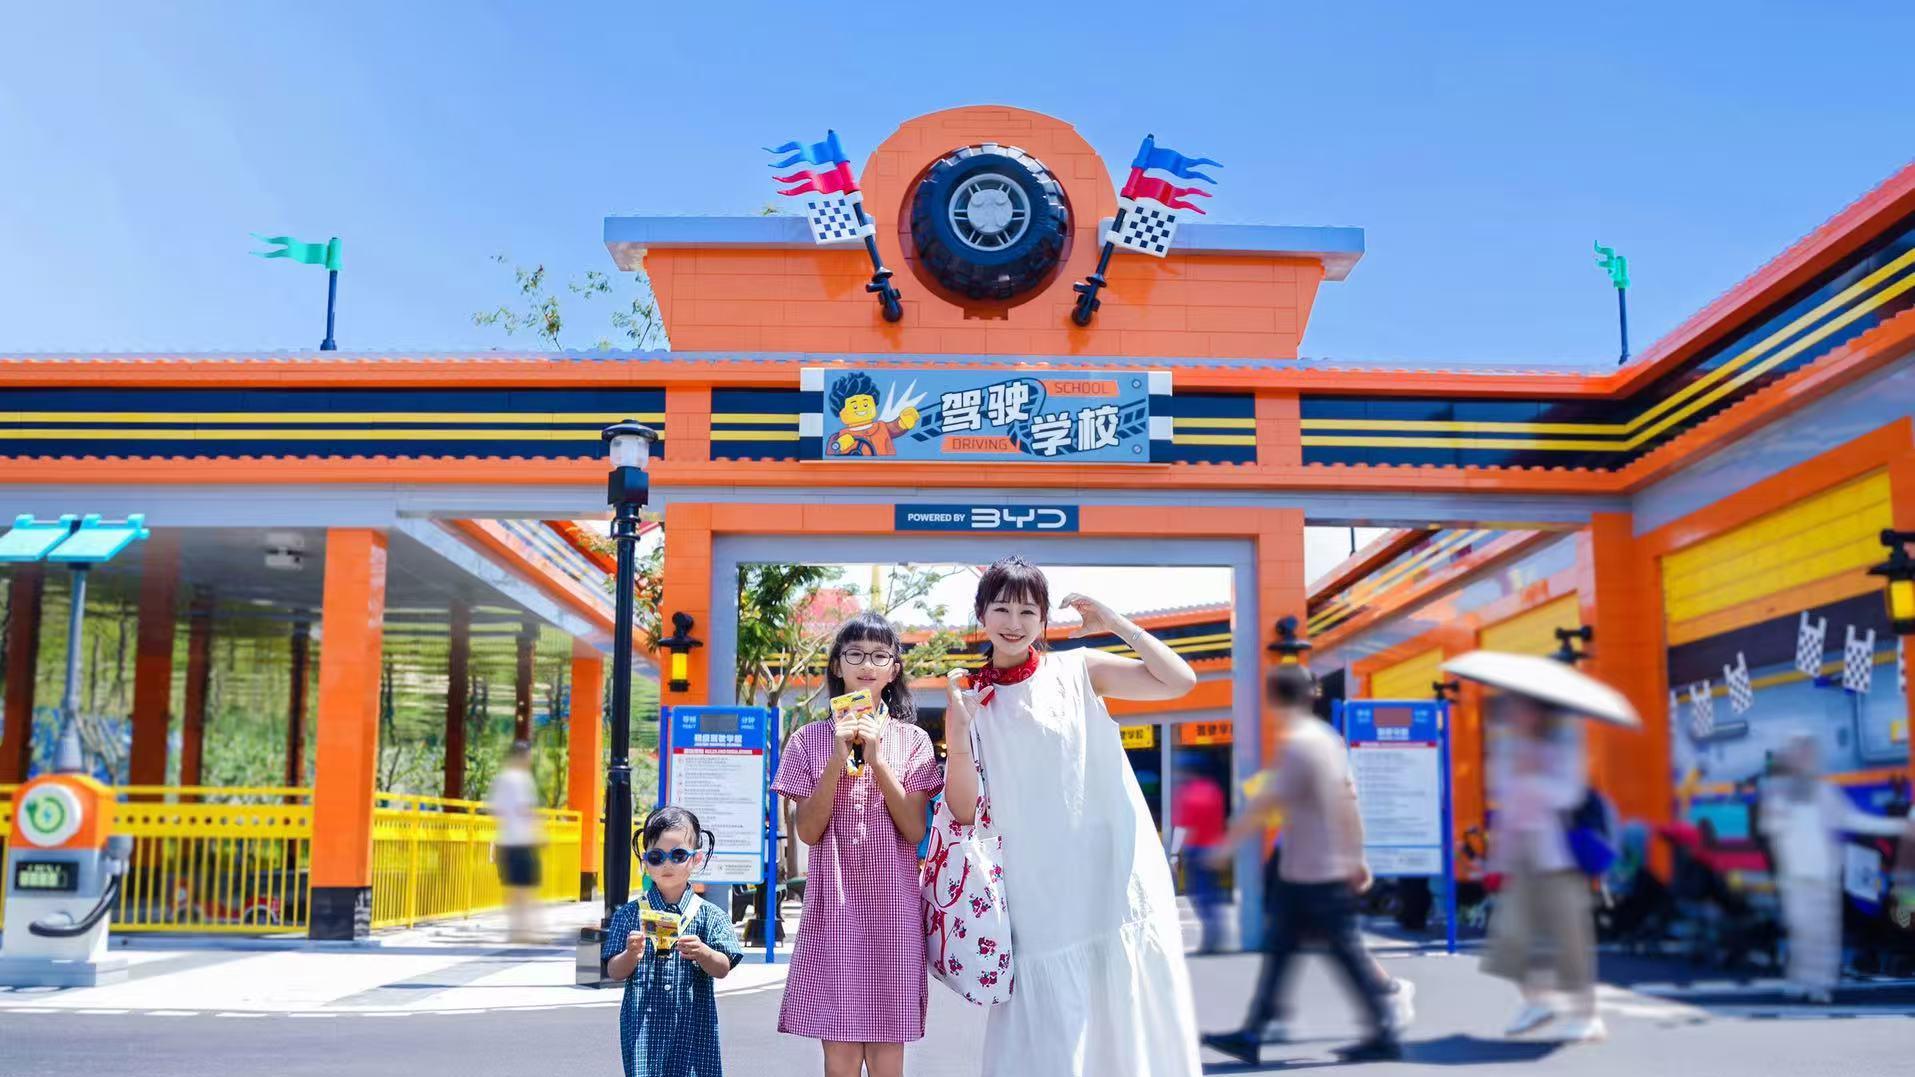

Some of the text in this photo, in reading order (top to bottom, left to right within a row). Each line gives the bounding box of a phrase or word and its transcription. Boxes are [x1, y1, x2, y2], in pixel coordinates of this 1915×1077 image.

[1055, 382, 1107, 395] SCHOOL
[941, 381, 1119, 457] 驾驶学校
[952, 438, 1008, 450] DRIVING
[907, 508, 1067, 529] POWERED BY BYD
